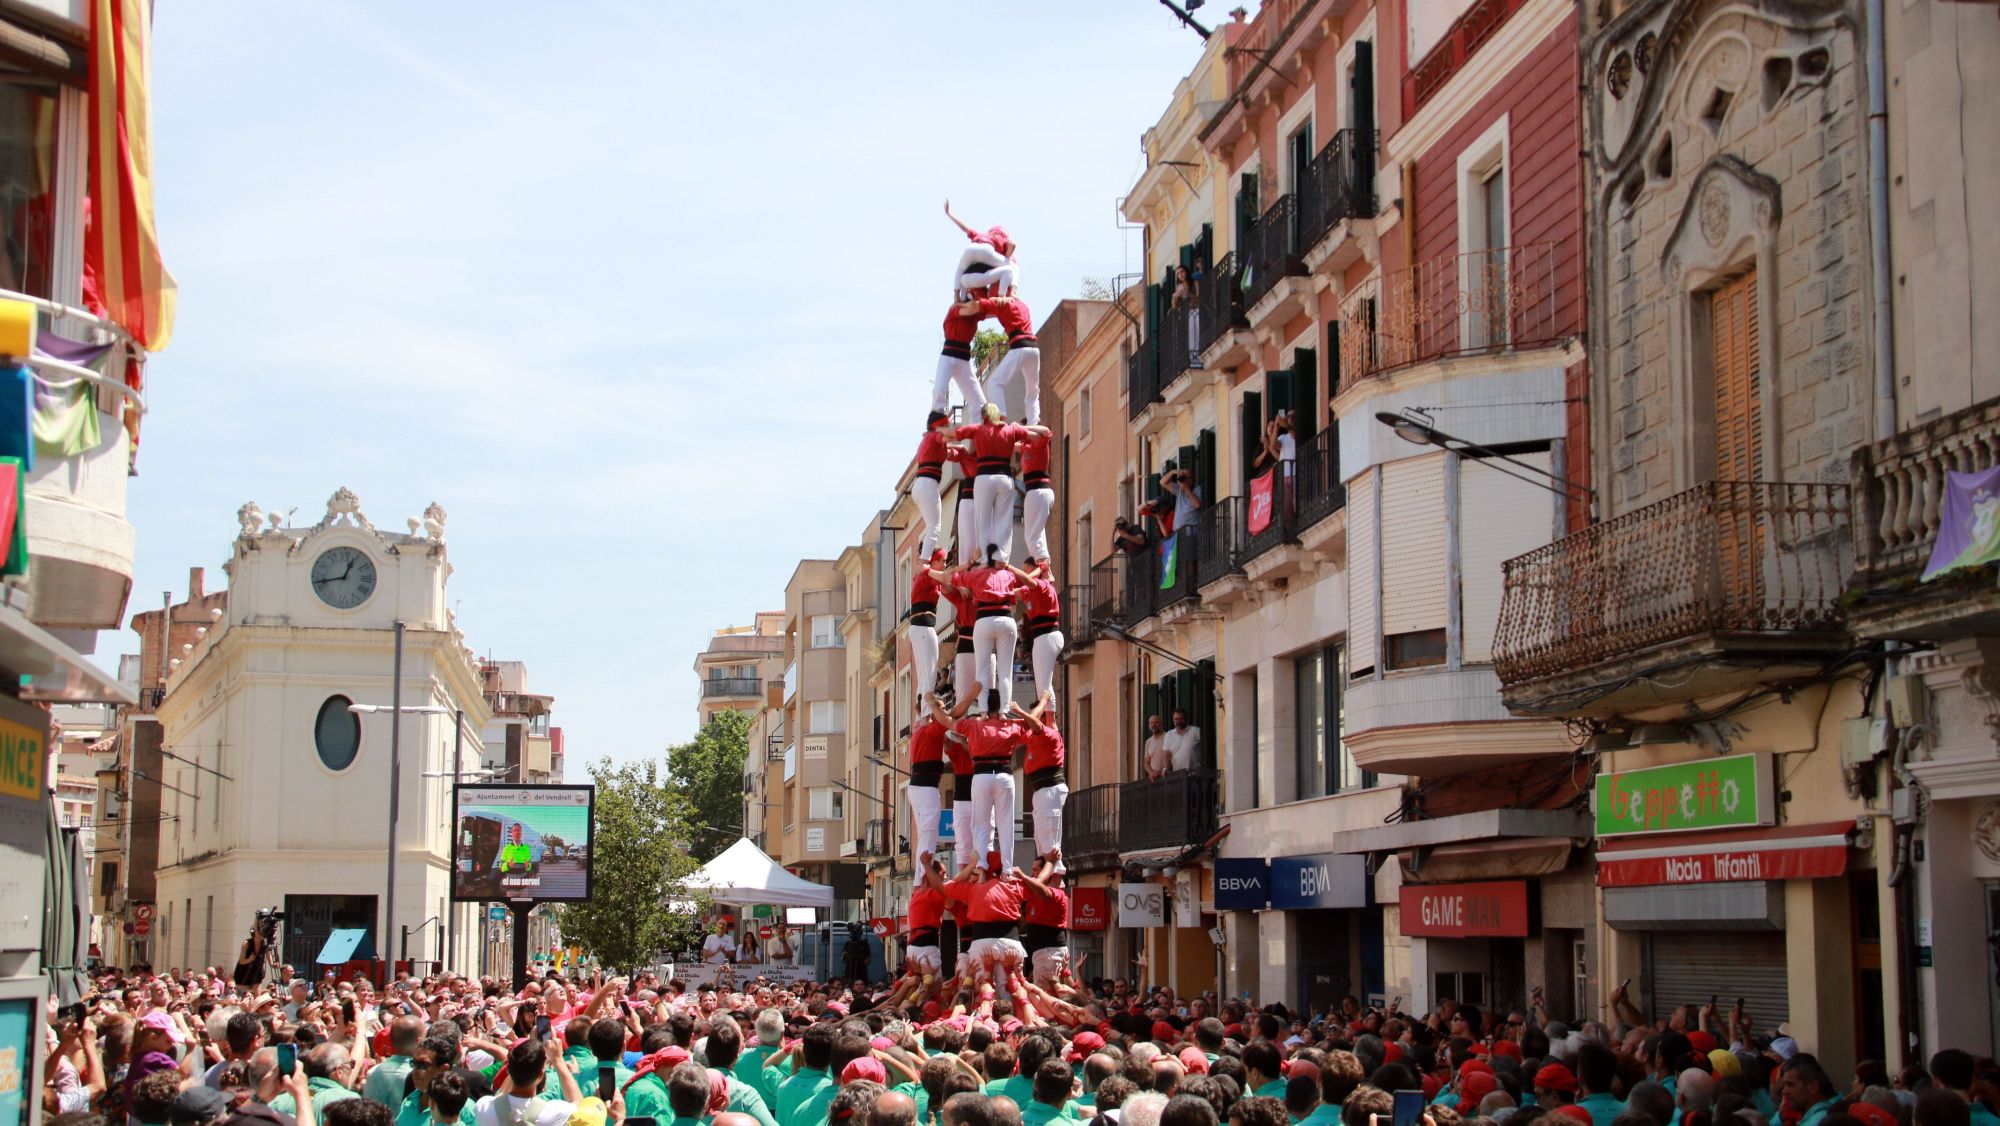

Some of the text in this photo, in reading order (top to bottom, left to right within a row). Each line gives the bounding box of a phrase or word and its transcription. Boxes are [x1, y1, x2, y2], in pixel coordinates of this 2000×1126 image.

[476, 792, 515, 800] Ajuntament
[1609, 770, 1740, 830] Geppetto
[1301, 861, 1331, 896] BBVA
[1665, 853, 1760, 882] Moda Infantil
[1219, 876, 1261, 890] BBVA
[1124, 893, 1161, 910] OVS
